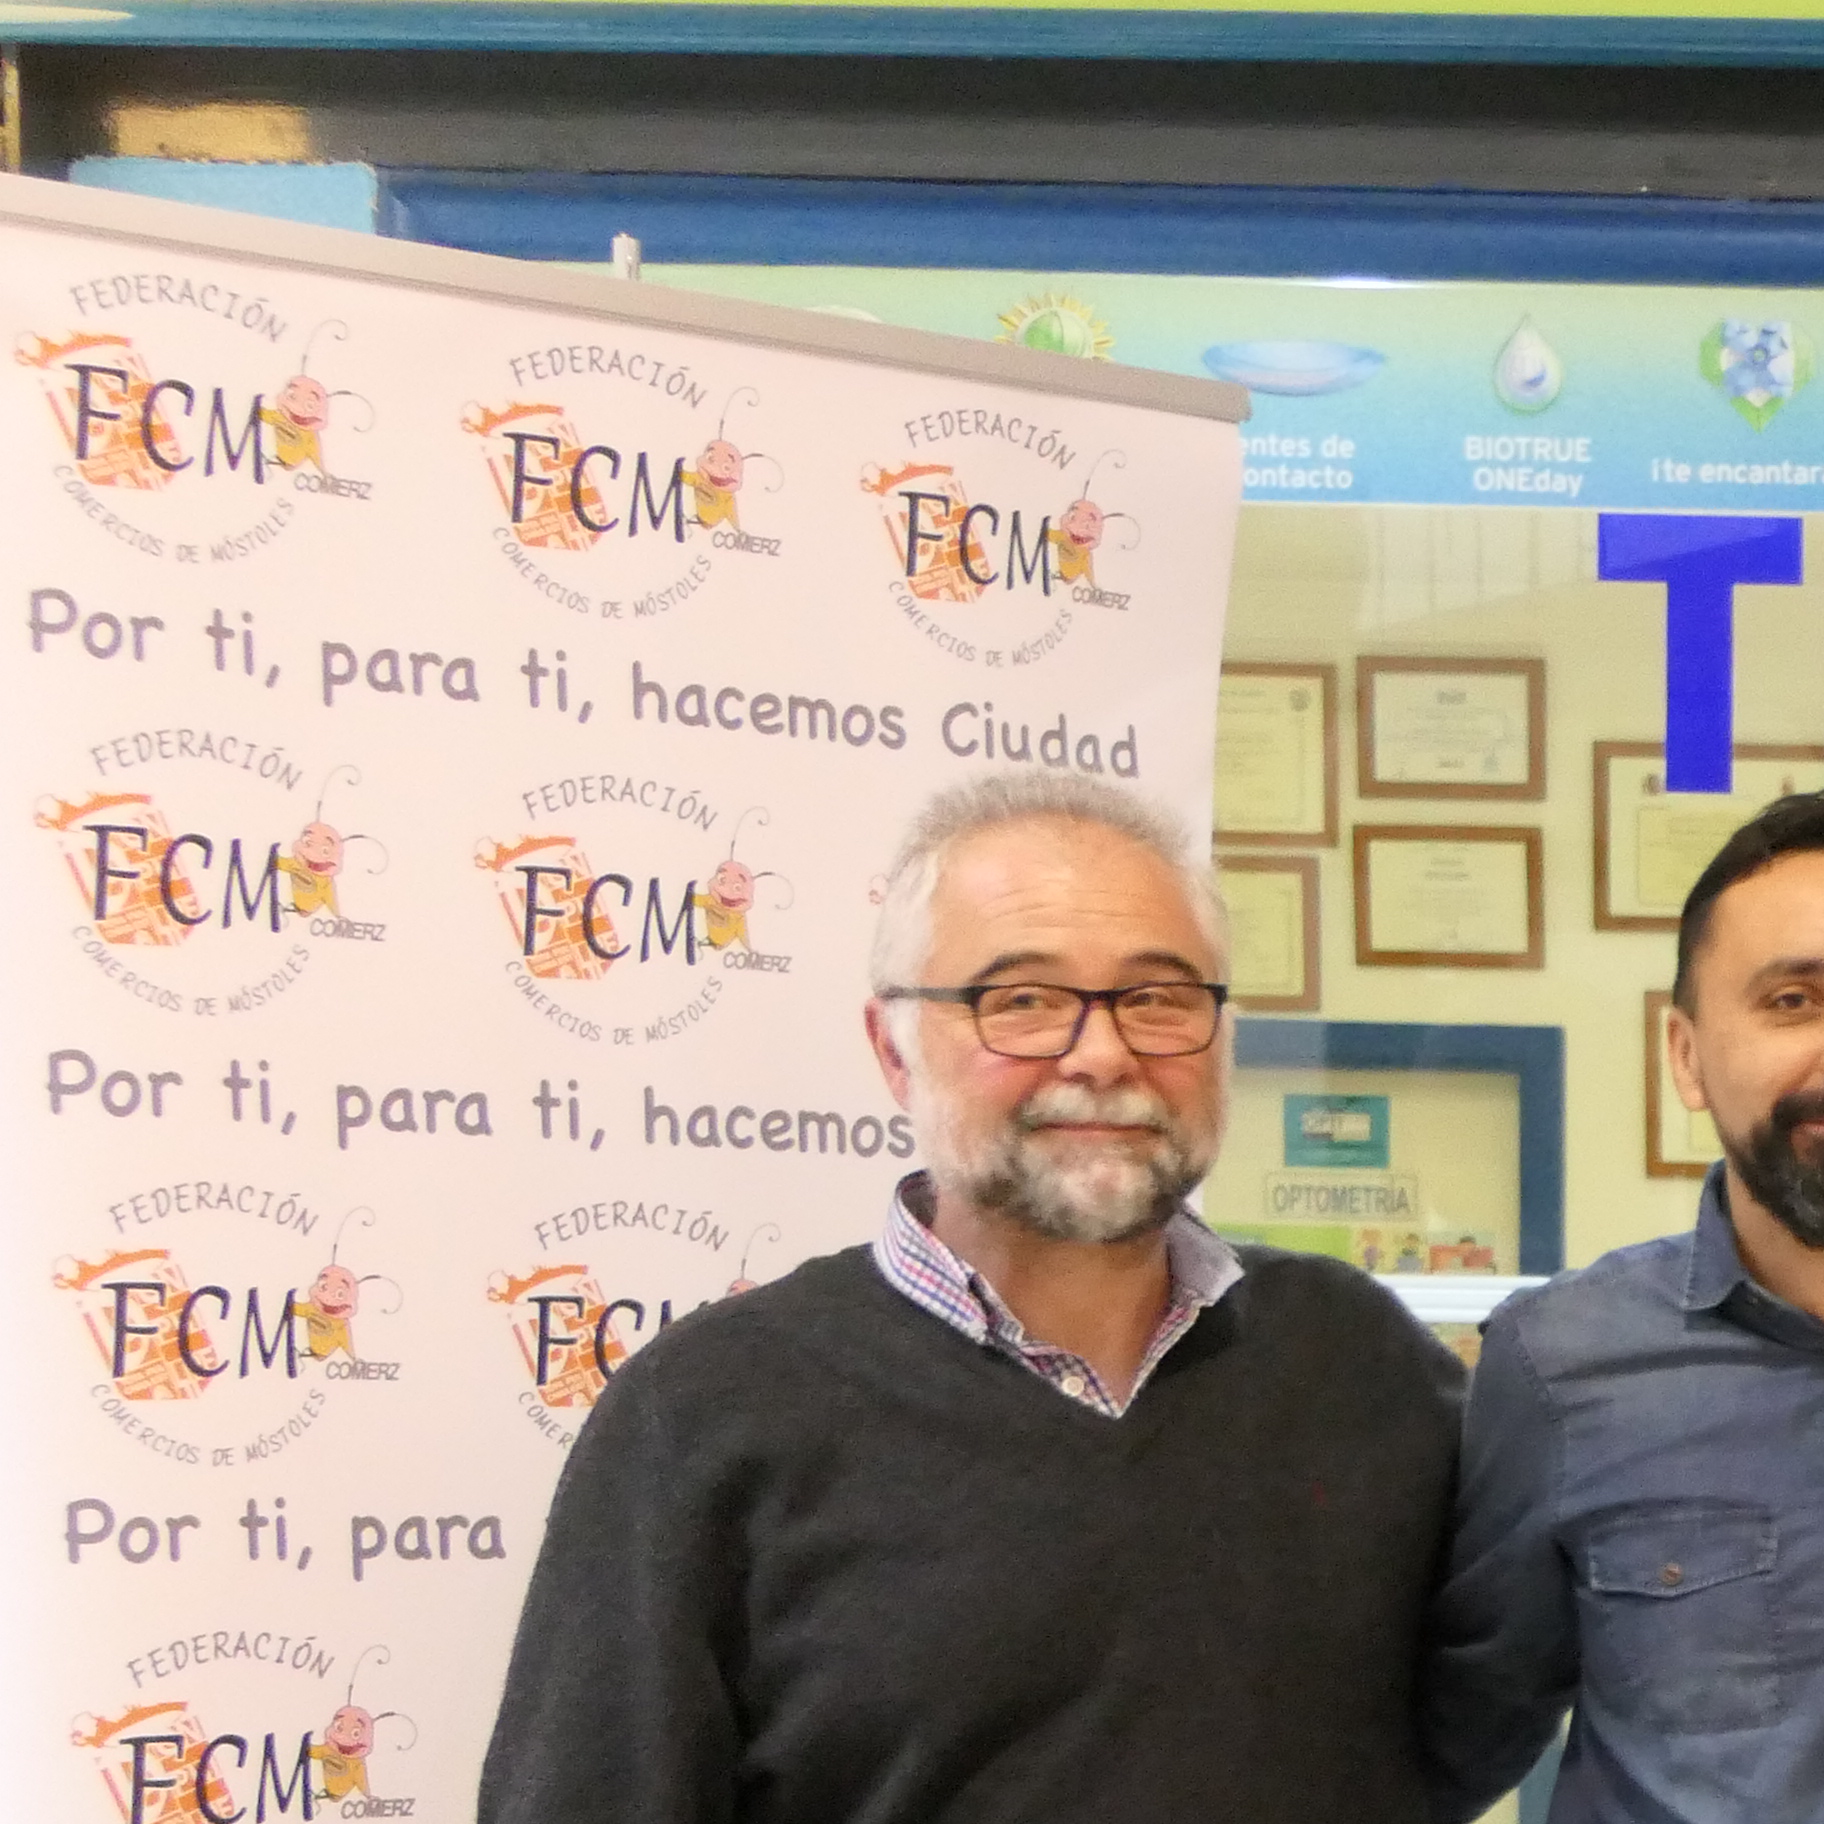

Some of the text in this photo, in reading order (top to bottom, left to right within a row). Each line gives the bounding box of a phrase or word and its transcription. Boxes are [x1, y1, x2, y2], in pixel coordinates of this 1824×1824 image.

[69, 275, 287, 342] FEDERACIÓN
[509, 346, 706, 408] FEDERACIÓN
[65, 364, 264, 484] FCM
[904, 410, 1076, 470] FEDERACIÓN
[1239, 433, 1355, 459] entes de
[1464, 435, 1590, 462] BIOTRUE
[503, 433, 684, 543] FCM
[1242, 462, 1355, 491] ontacto
[1474, 466, 1583, 495] ONEday
[898, 491, 1050, 596] FCM
[28, 588, 164, 661] Por
[205, 609, 280, 688] ti,
[322, 641, 479, 707] para
[520, 648, 592, 723] ti,
[632, 661, 906, 749] hacemos
[942, 702, 1138, 776] Ciudad
[90, 729, 302, 791] FEDERACIÓN
[522, 775, 718, 831] FEDERACIÓN
[83, 825, 280, 932] FCM
[515, 866, 703, 965] FCM
[72, 925, 309, 1016] COMERCIOS DE MÓSTOLES
[46, 1049, 914, 1158] Por ti, para ti, hacemos
[109, 1181, 318, 1236] FEDERACIÓN
[534, 1201, 729, 1251] FEDERACIÓN
[102, 1282, 296, 1378] FCM
[64, 1497, 506, 1581] Por ti, para
[127, 1631, 334, 1688] FEDERACIÓN
